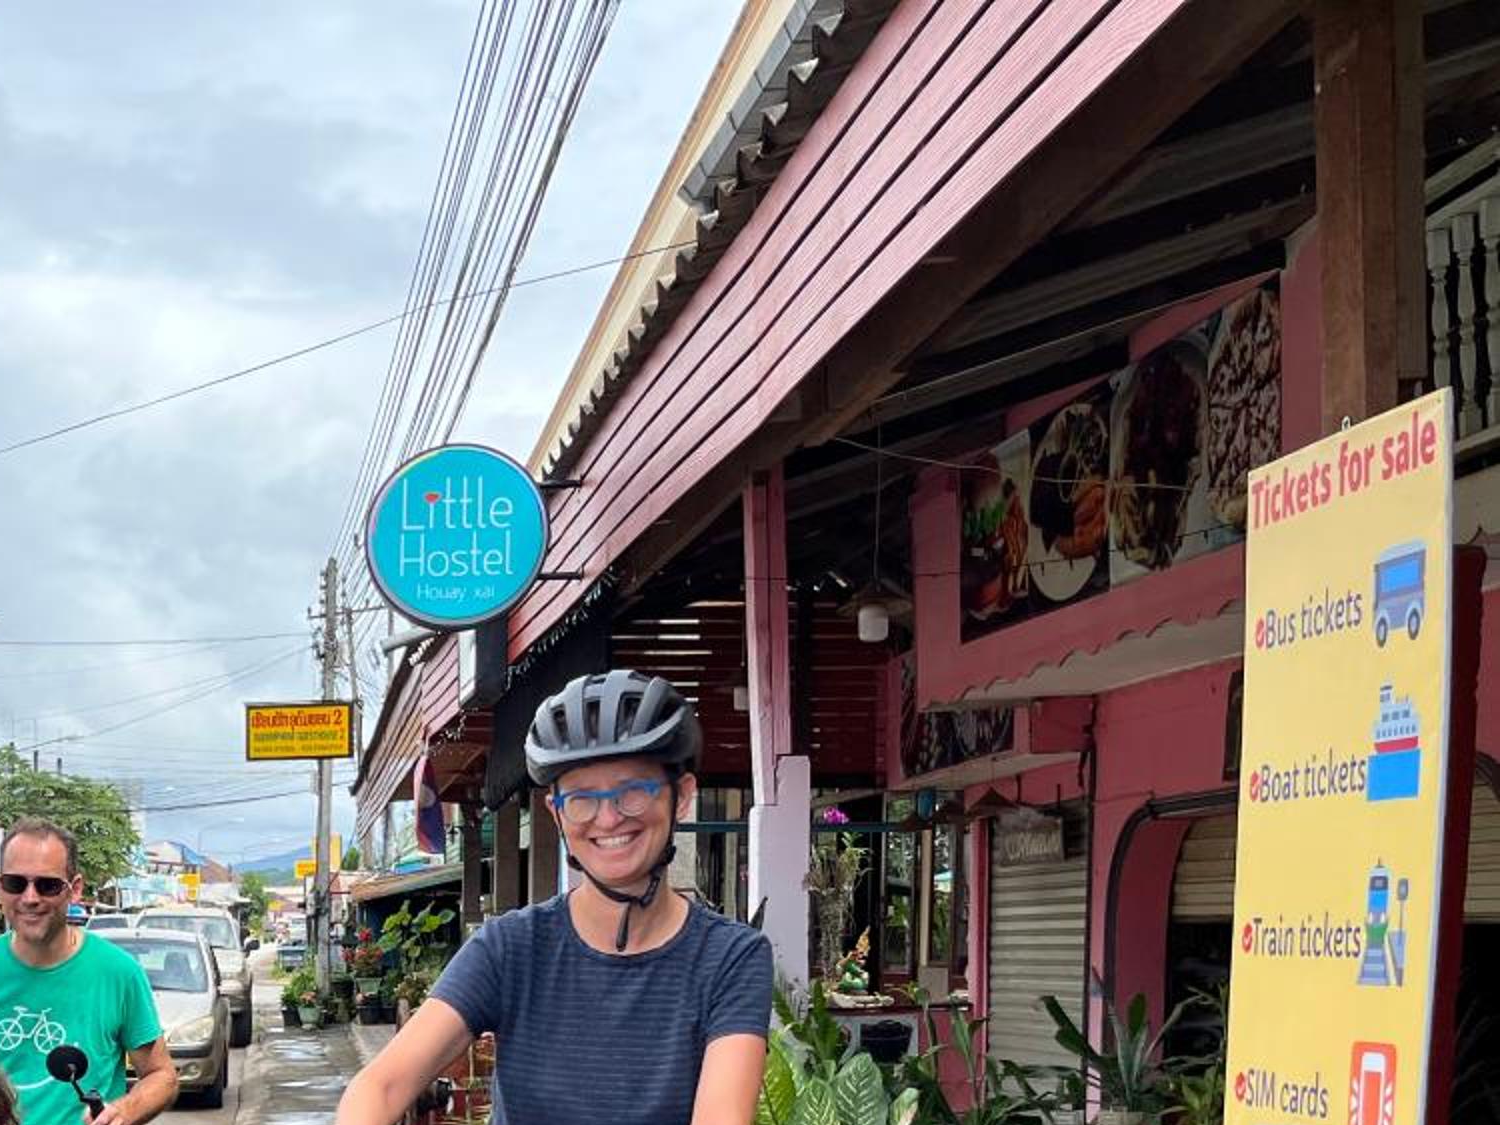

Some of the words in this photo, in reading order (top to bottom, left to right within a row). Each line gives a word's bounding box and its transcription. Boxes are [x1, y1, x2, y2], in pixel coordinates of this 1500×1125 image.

[1251, 460, 1331, 529] Tickets
[1338, 440, 1375, 493] for
[1382, 412, 1436, 482] sale
[403, 475, 514, 530] Little
[399, 529, 514, 577] Hostel
[1265, 608, 1295, 649] Bus
[1301, 587, 1363, 639] tickets
[1260, 764, 1300, 802] Boat
[1304, 748, 1367, 797] tickets
[1252, 913, 1296, 957] Train
[1300, 913, 1362, 958] tickets
[1245, 1068, 1276, 1108] SIM
[1279, 1073, 1328, 1119] cards
